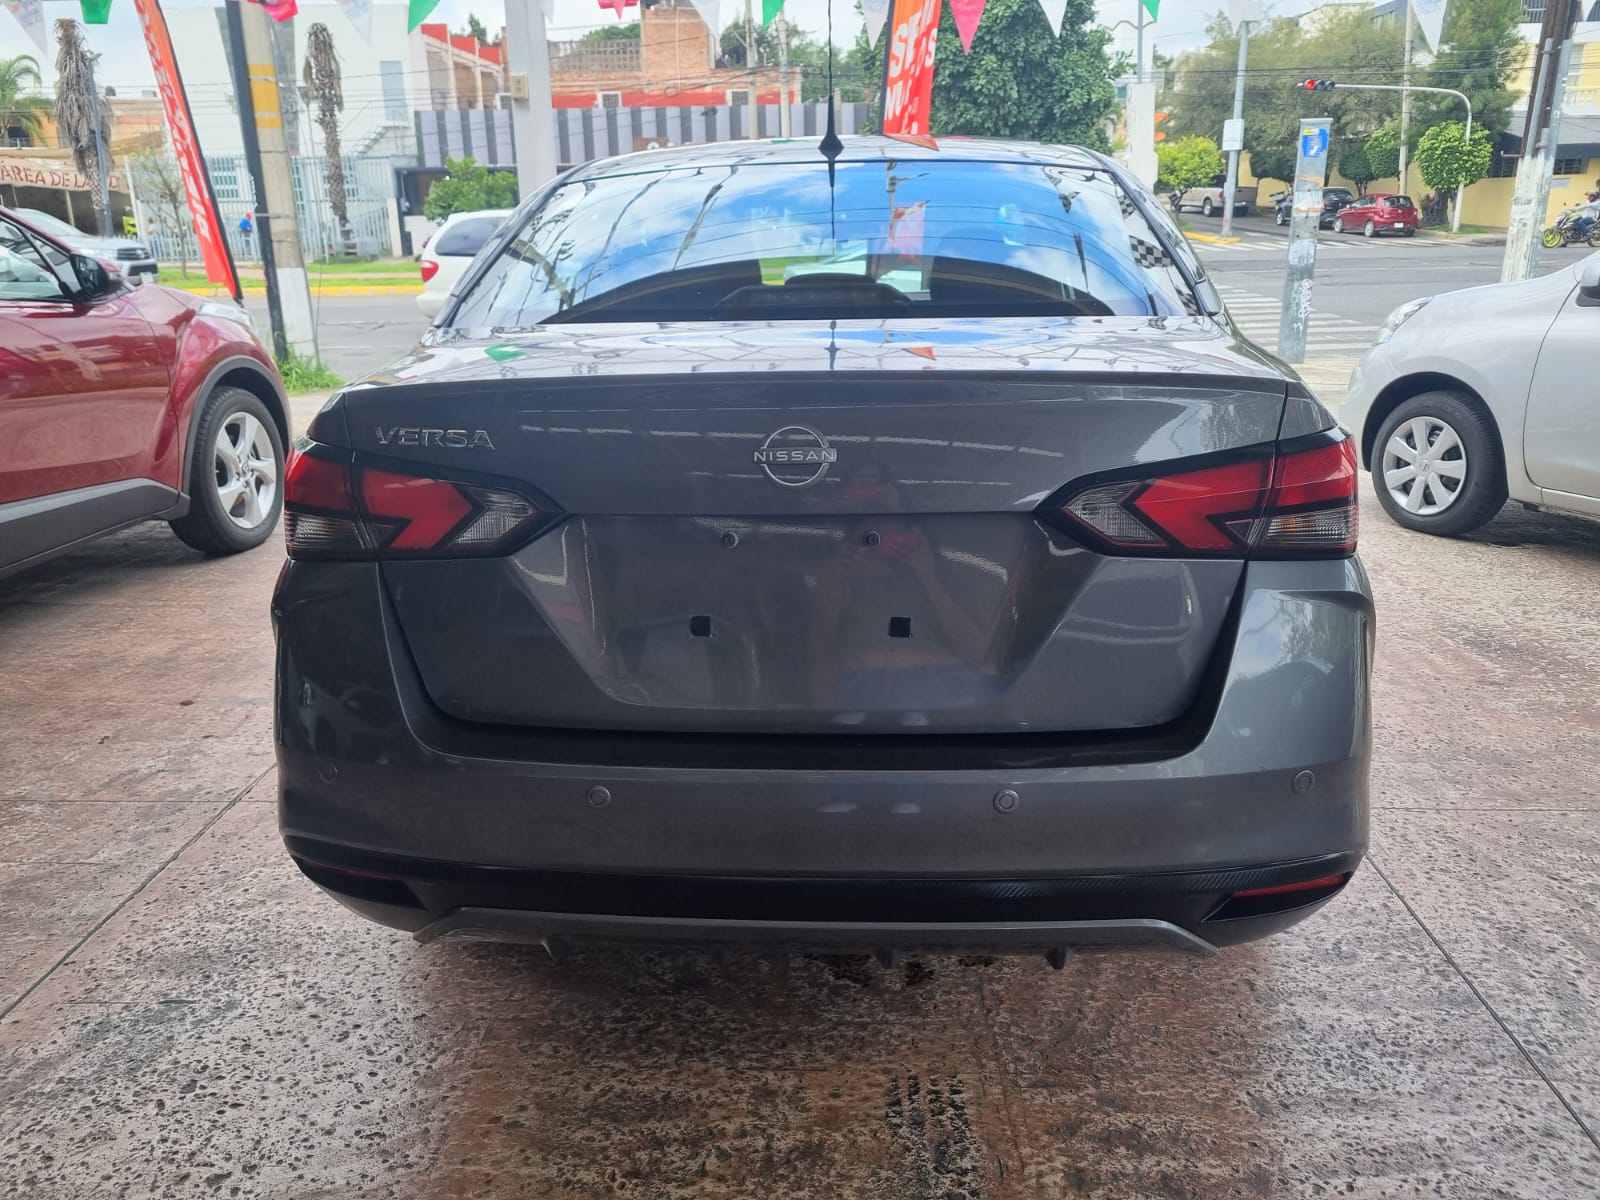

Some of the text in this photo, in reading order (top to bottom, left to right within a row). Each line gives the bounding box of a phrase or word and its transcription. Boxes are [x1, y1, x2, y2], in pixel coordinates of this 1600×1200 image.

[0, 160, 46, 185] ÁREA
[49, 171, 70, 187] DE
[376, 426, 496, 450] VERSA
[753, 450, 835, 462] NISSAN
